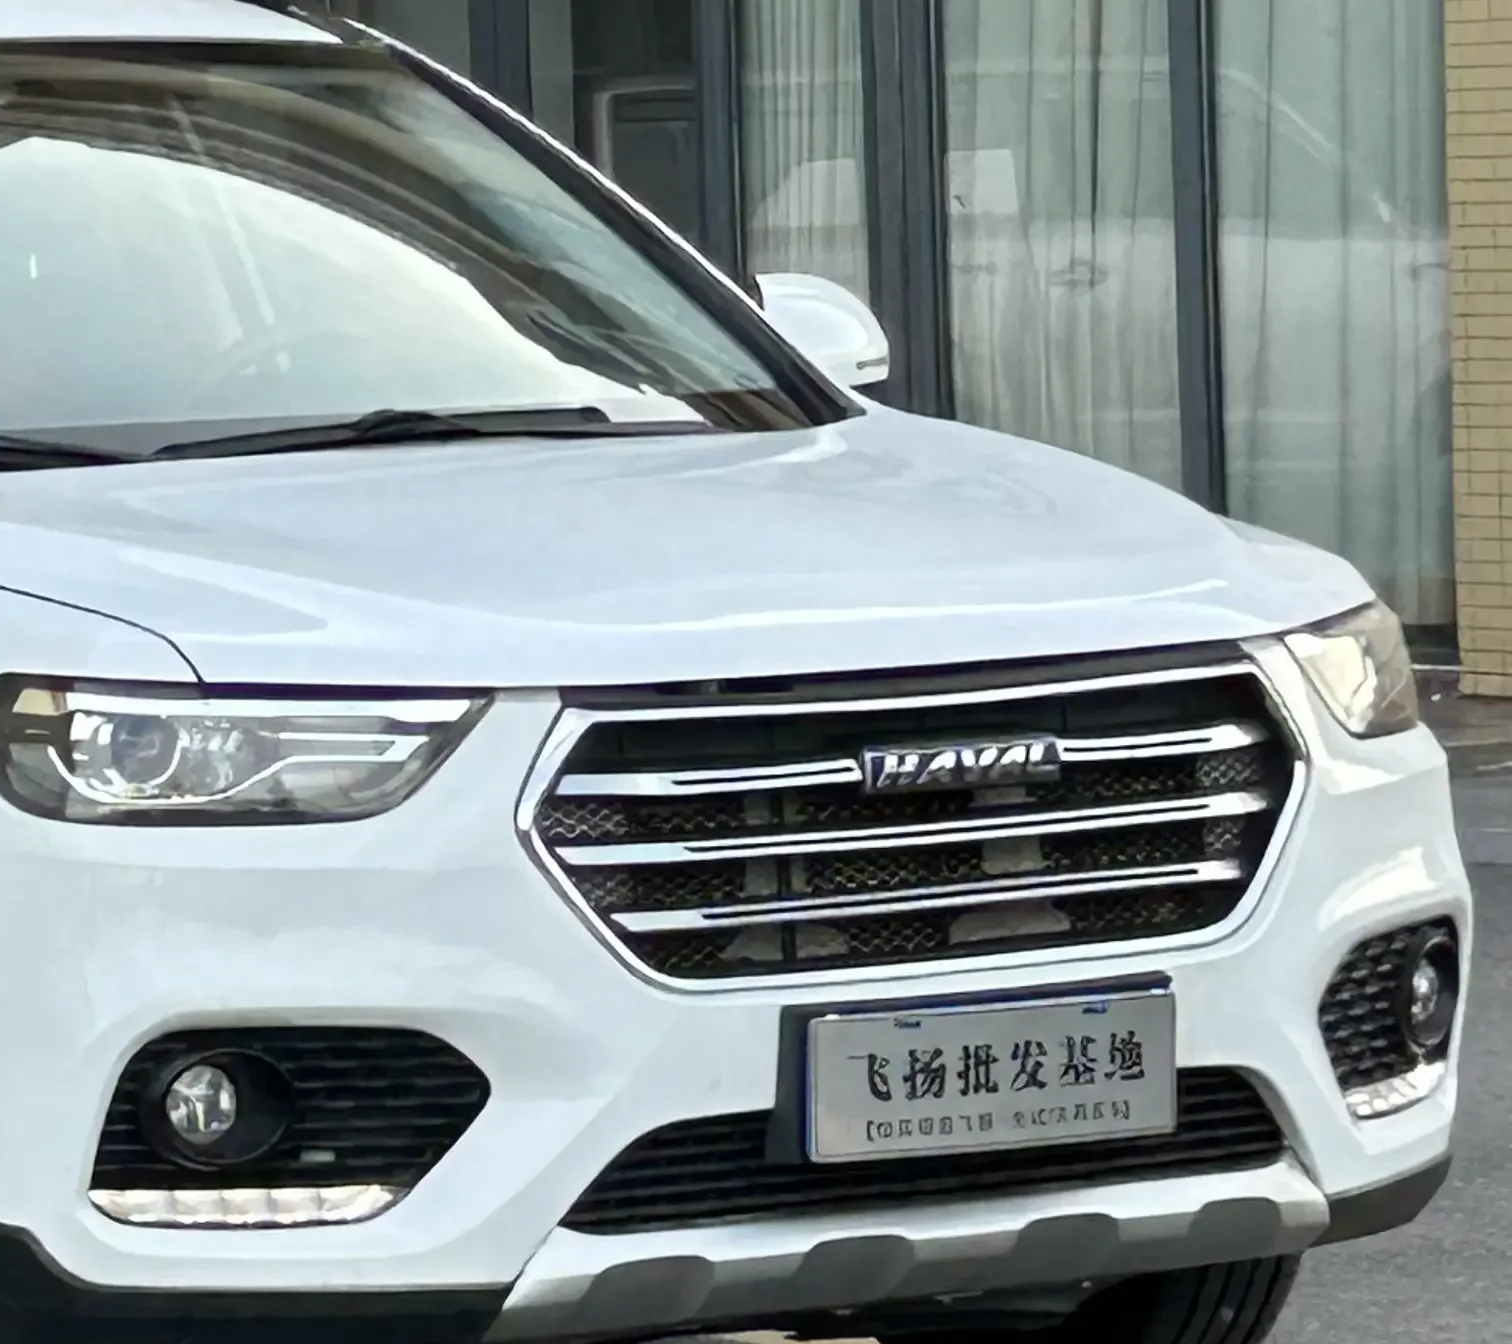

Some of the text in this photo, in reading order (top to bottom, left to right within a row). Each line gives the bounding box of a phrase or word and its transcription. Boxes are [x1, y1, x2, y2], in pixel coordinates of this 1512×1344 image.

[868, 741, 1061, 790] HAVAL
[848, 1030, 1145, 1101] 飞扬批发基地
